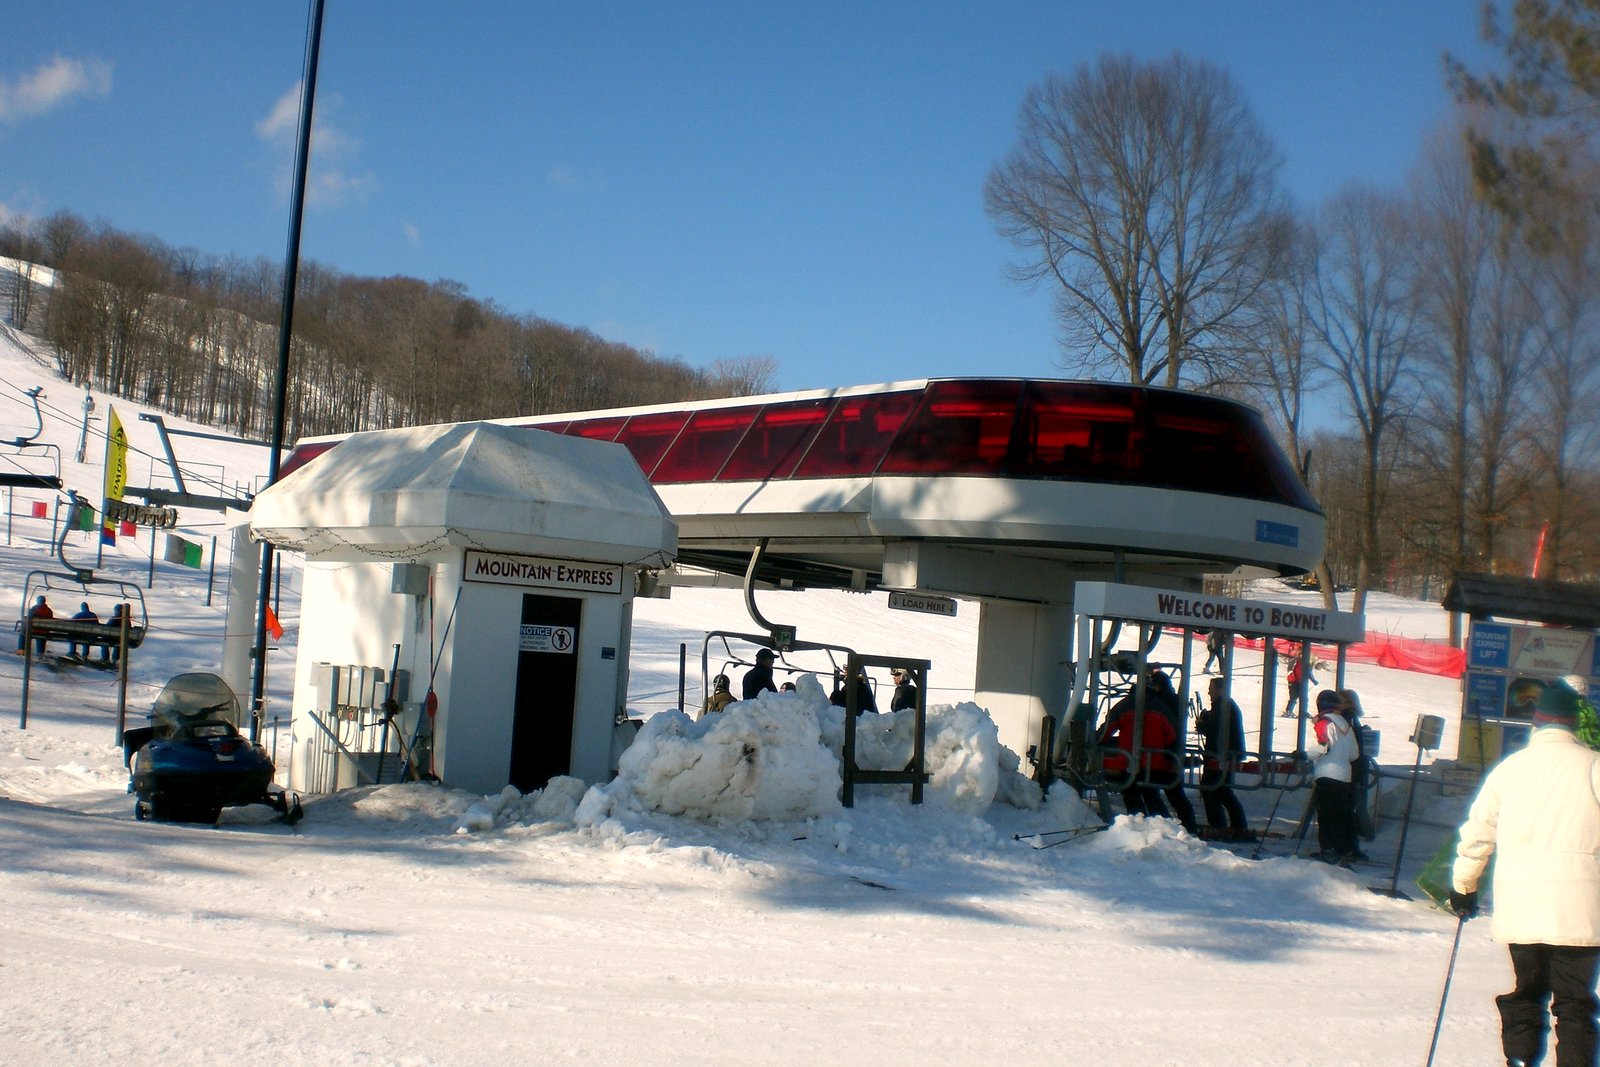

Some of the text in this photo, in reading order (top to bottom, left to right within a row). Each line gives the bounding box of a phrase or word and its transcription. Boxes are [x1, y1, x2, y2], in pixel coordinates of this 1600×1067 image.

[475, 557, 613, 586] MOUNTAIN EXPRESS
[902, 597, 946, 612] LOAD HERE
[1158, 593, 1326, 631] WELCOME TO BOYNE!
[520, 626, 552, 636] NOTICE
[1480, 650, 1498, 659] LIFT
